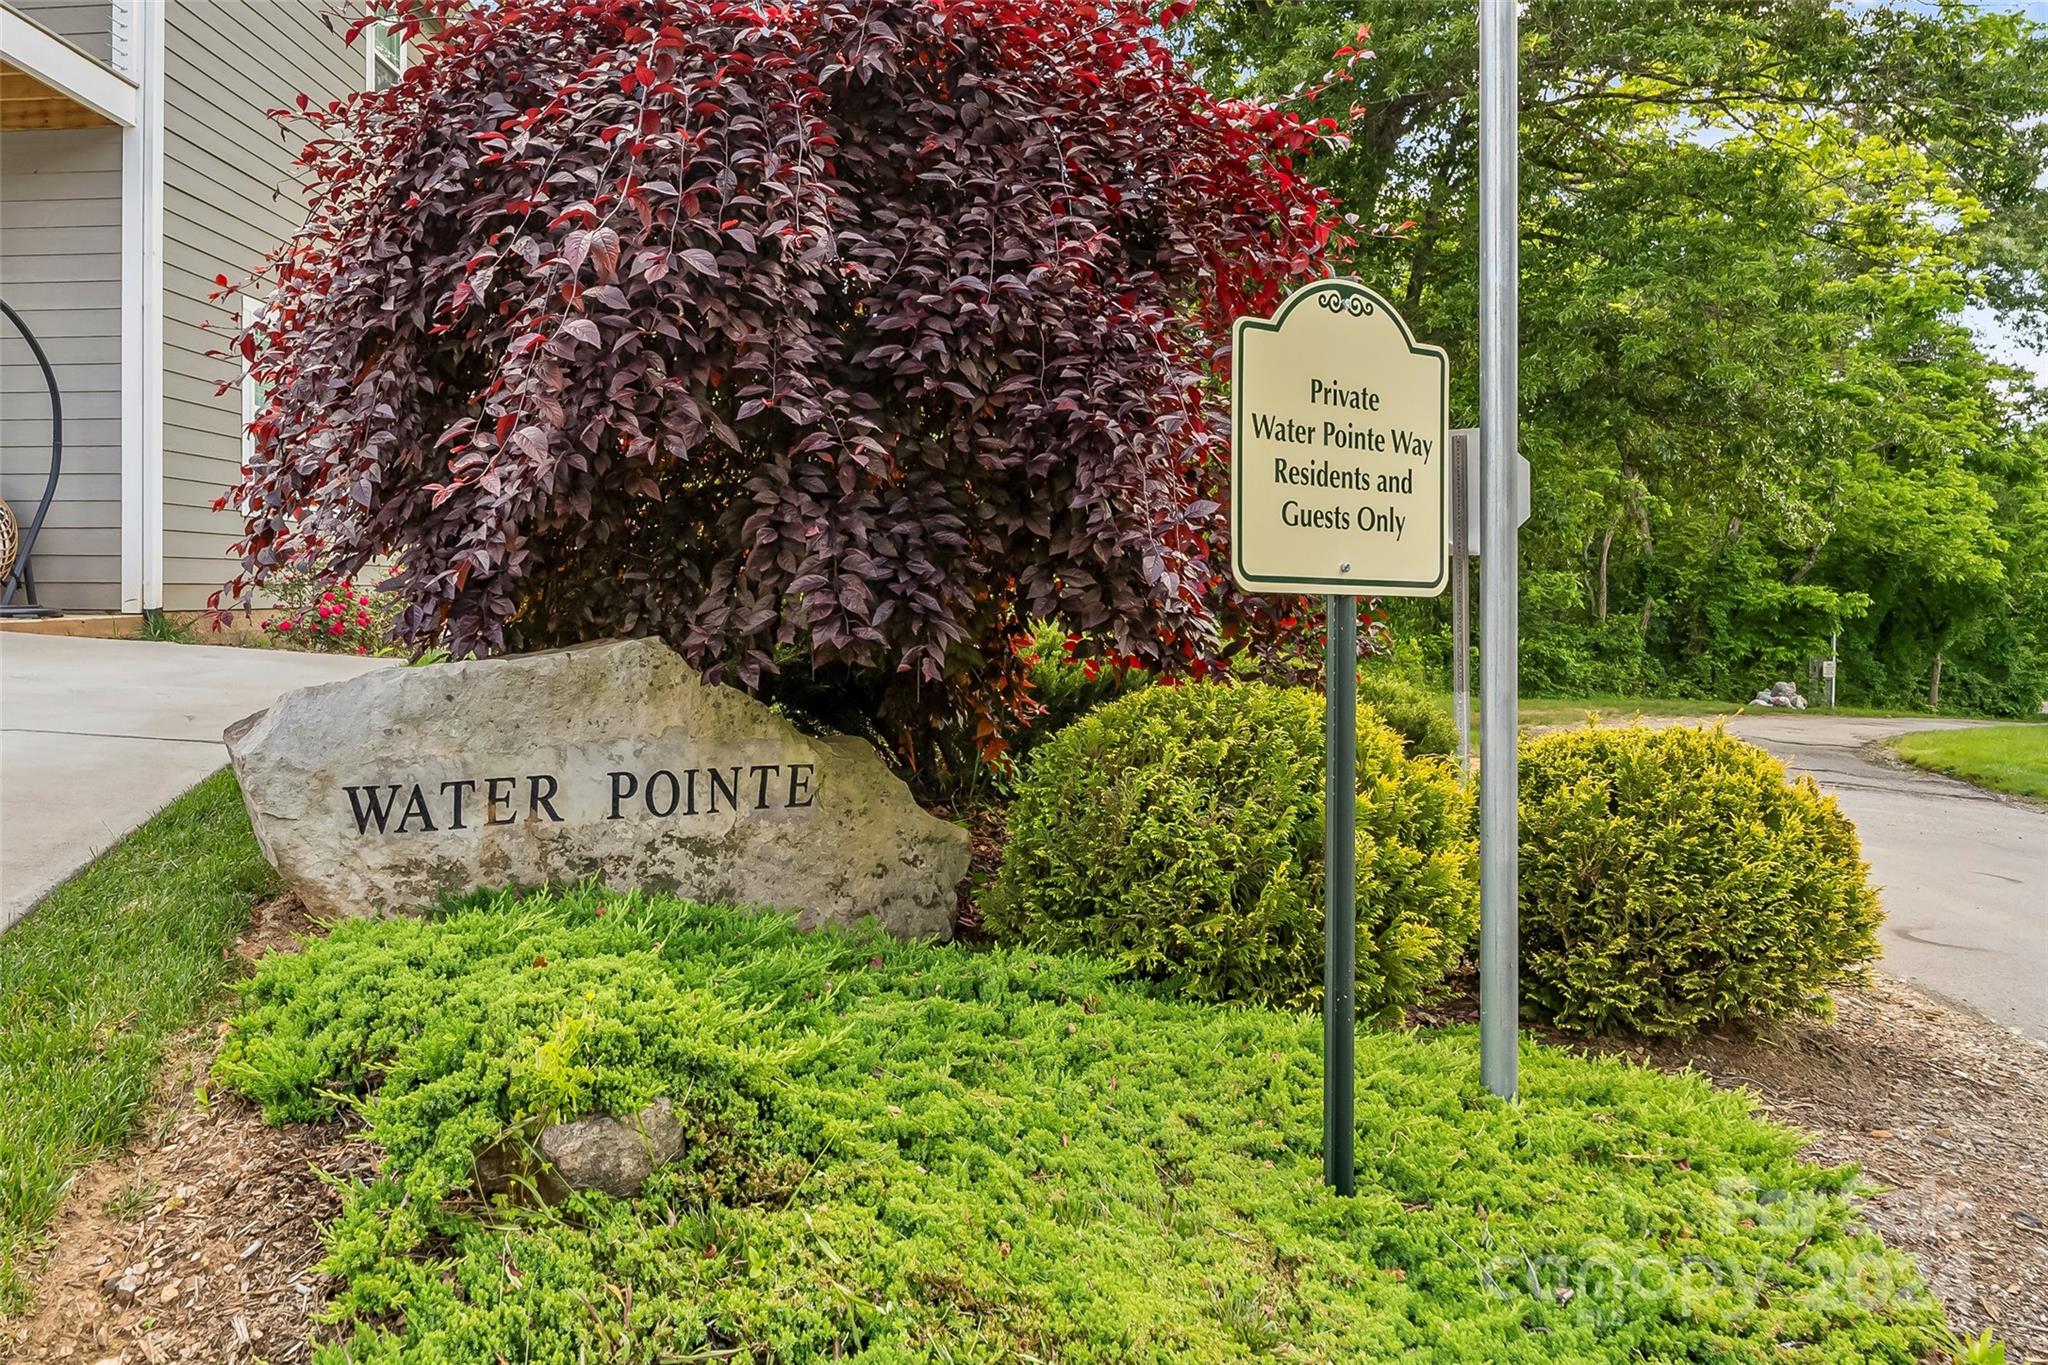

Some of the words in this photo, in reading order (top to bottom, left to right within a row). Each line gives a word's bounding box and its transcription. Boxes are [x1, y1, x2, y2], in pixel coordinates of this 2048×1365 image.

[1310, 378, 1380, 411] Private
[1251, 412, 1316, 445] Water
[1323, 421, 1386, 452] Pointe
[1391, 429, 1433, 464] Way
[1274, 457, 1370, 491] Residents
[1376, 469, 1413, 494] and
[1281, 500, 1350, 530] Guests
[1357, 506, 1406, 541] Only
[342, 774, 565, 835] WATER
[606, 763, 815, 820] POINTE
